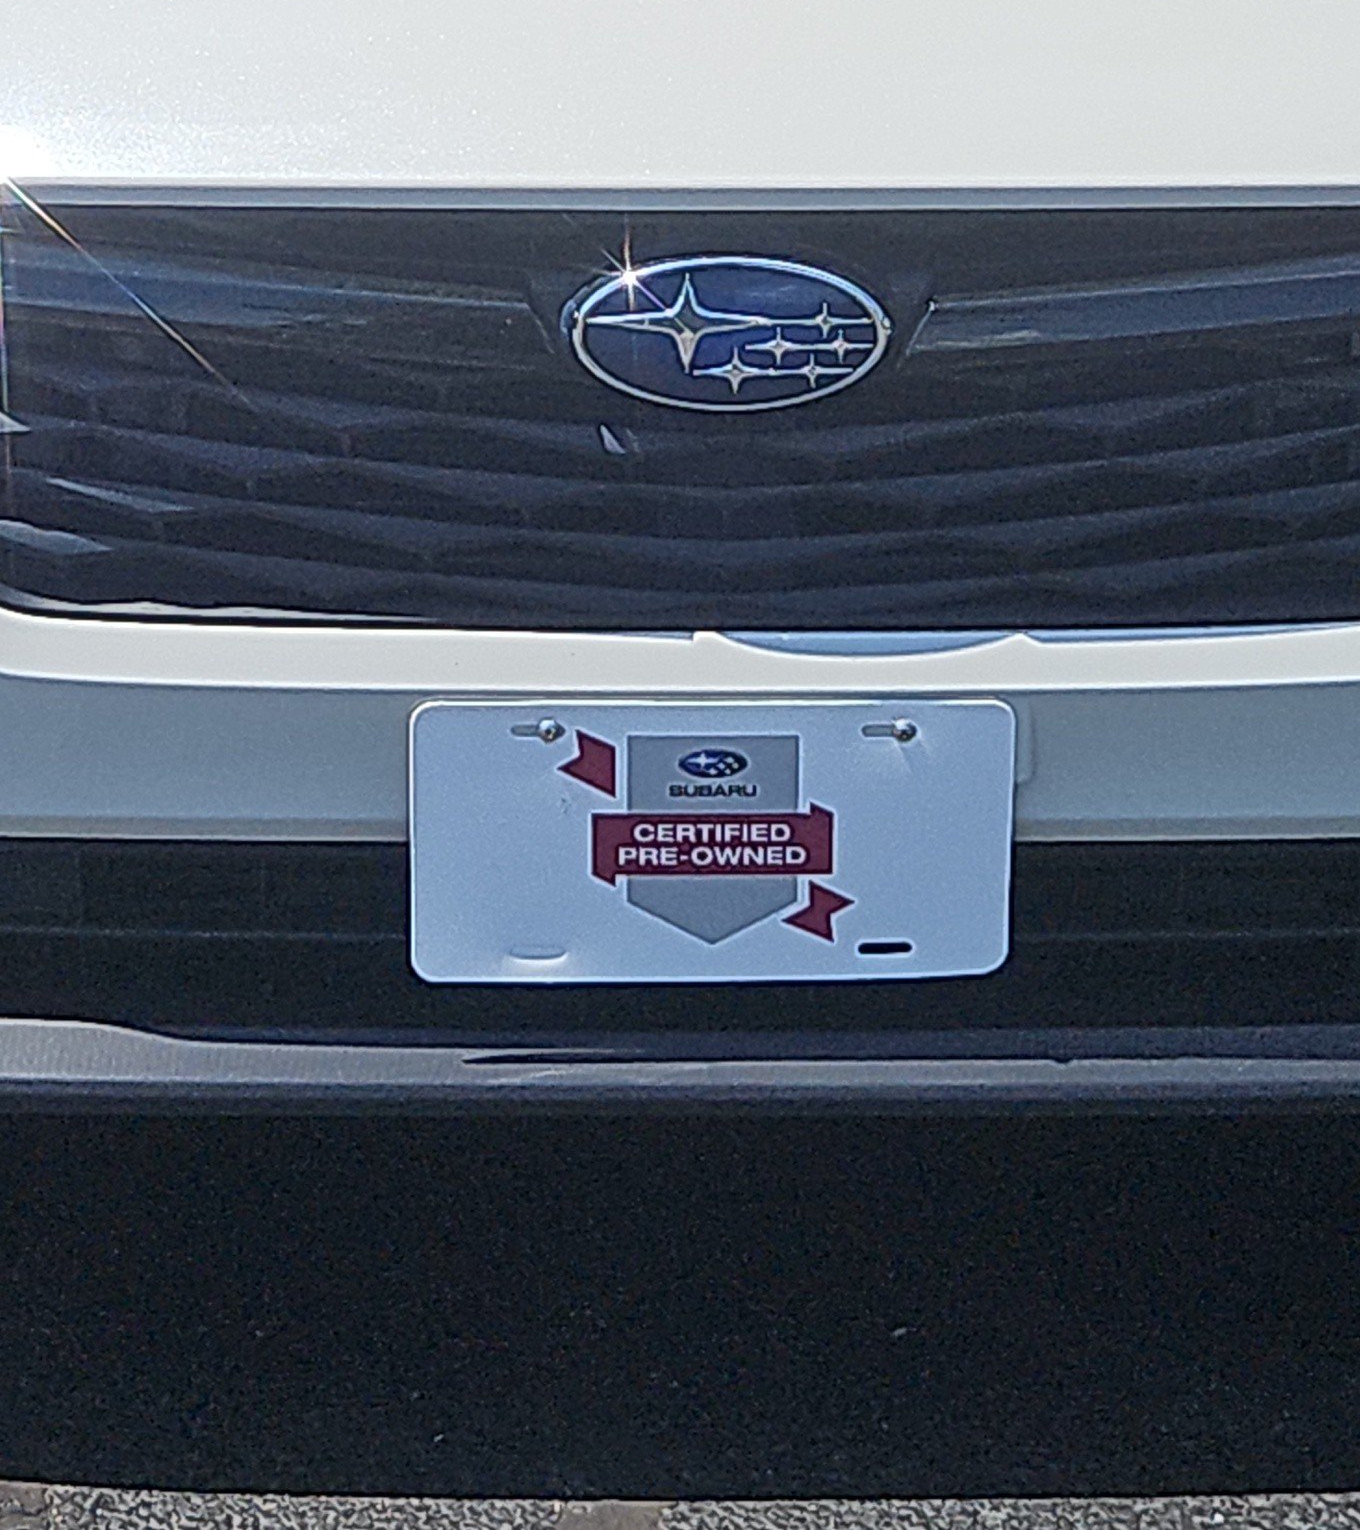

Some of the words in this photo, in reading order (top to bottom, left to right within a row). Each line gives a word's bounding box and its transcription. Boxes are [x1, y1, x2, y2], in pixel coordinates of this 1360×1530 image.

[668, 784, 757, 797] SUBARU
[633, 823, 791, 843] CERTIFIED
[618, 846, 807, 866] PRE-OWNED
